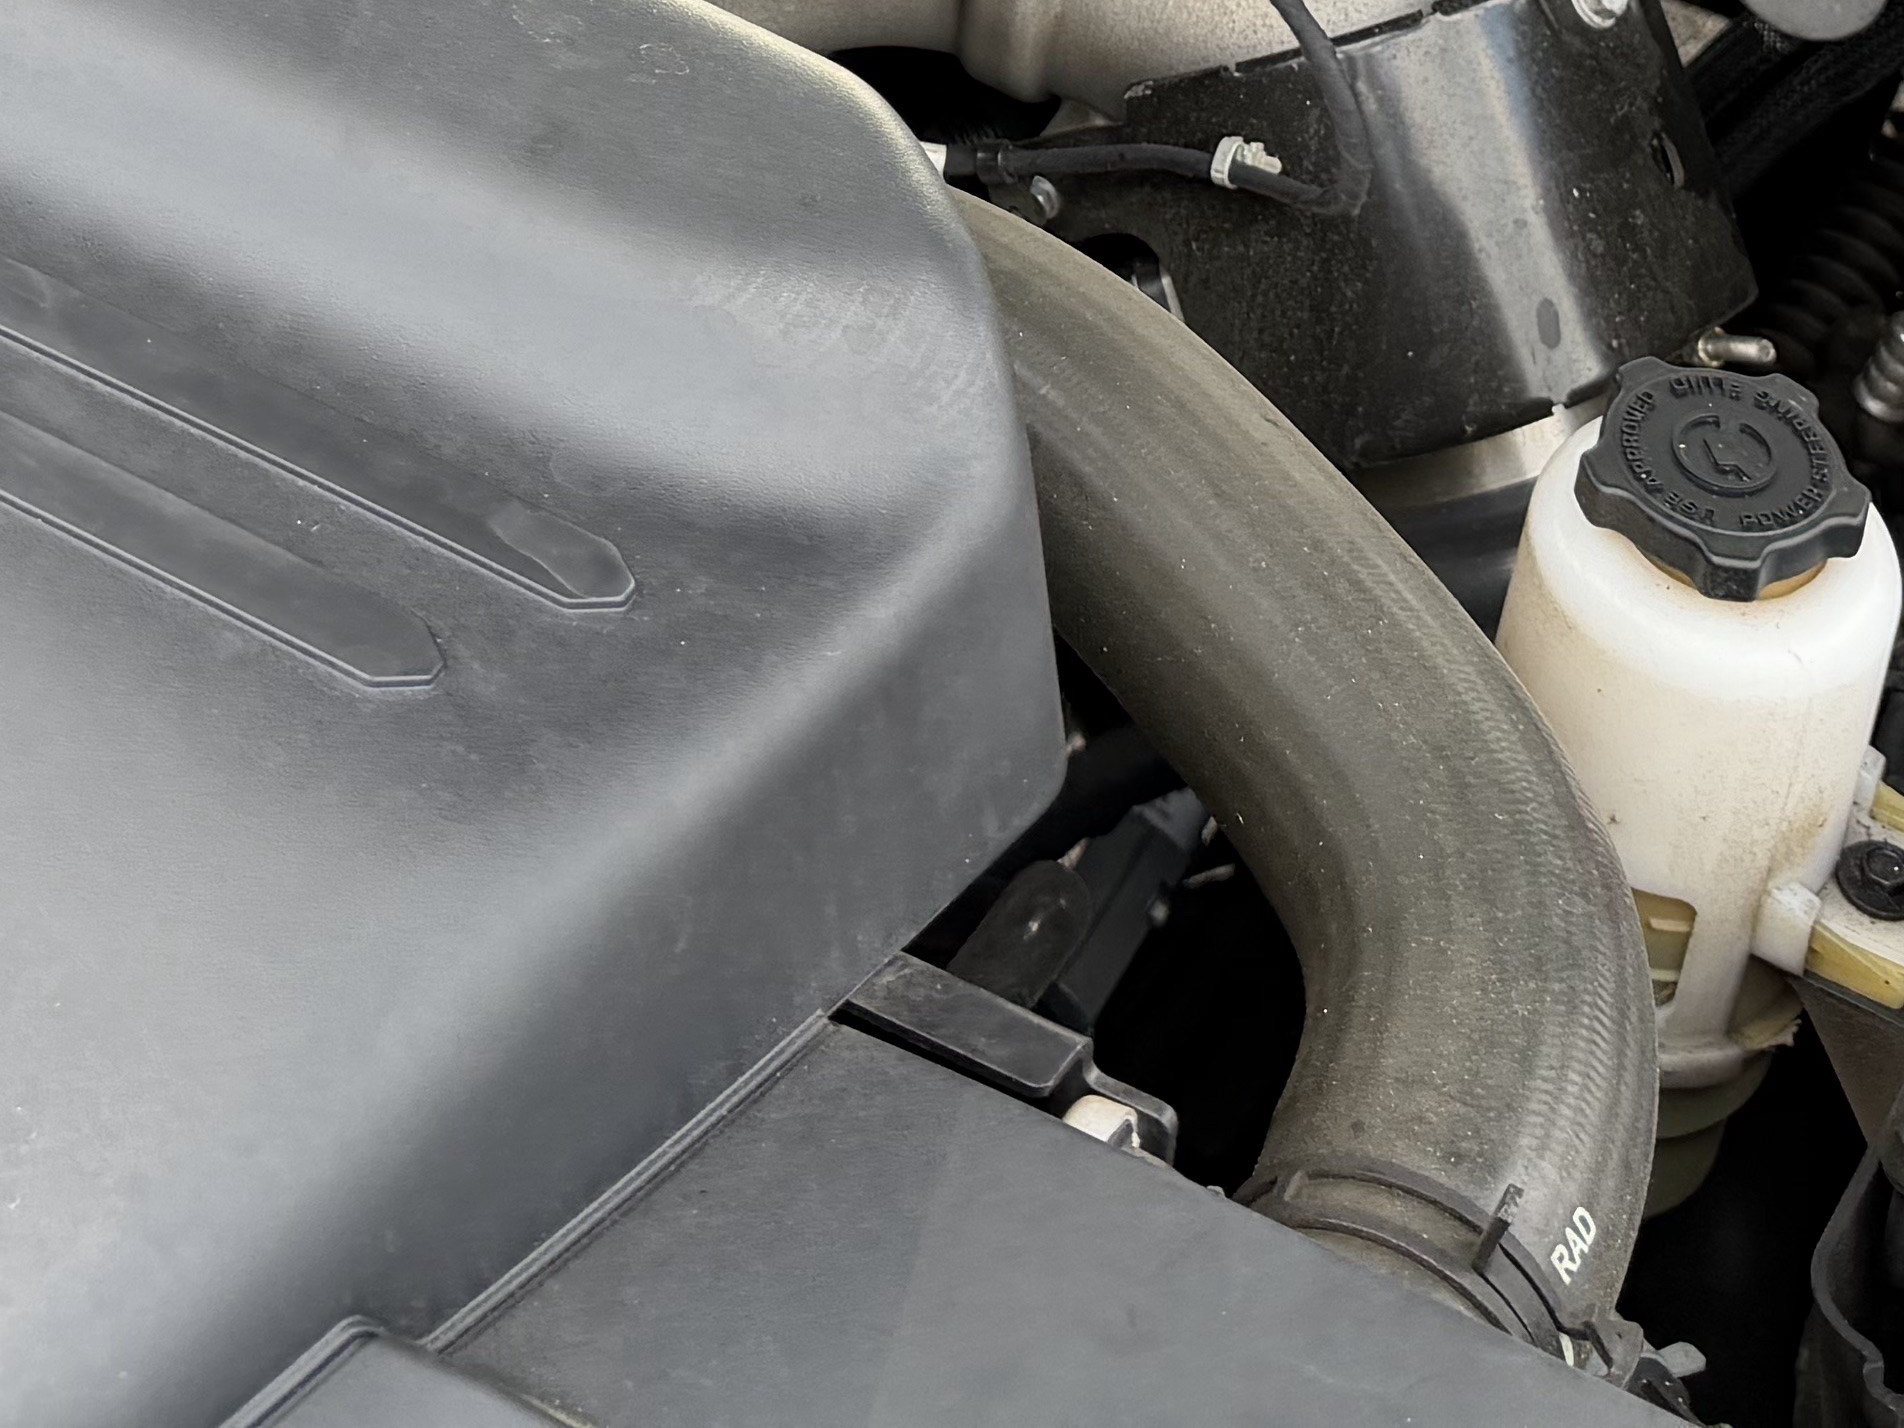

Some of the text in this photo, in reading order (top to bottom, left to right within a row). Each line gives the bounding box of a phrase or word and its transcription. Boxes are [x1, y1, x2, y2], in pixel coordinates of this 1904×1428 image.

[1620, 390, 1664, 494] APPROVED
[1753, 389, 1830, 484] STEERING
[1738, 486, 1823, 529] POWER
[1550, 1206, 1597, 1286] RAD
